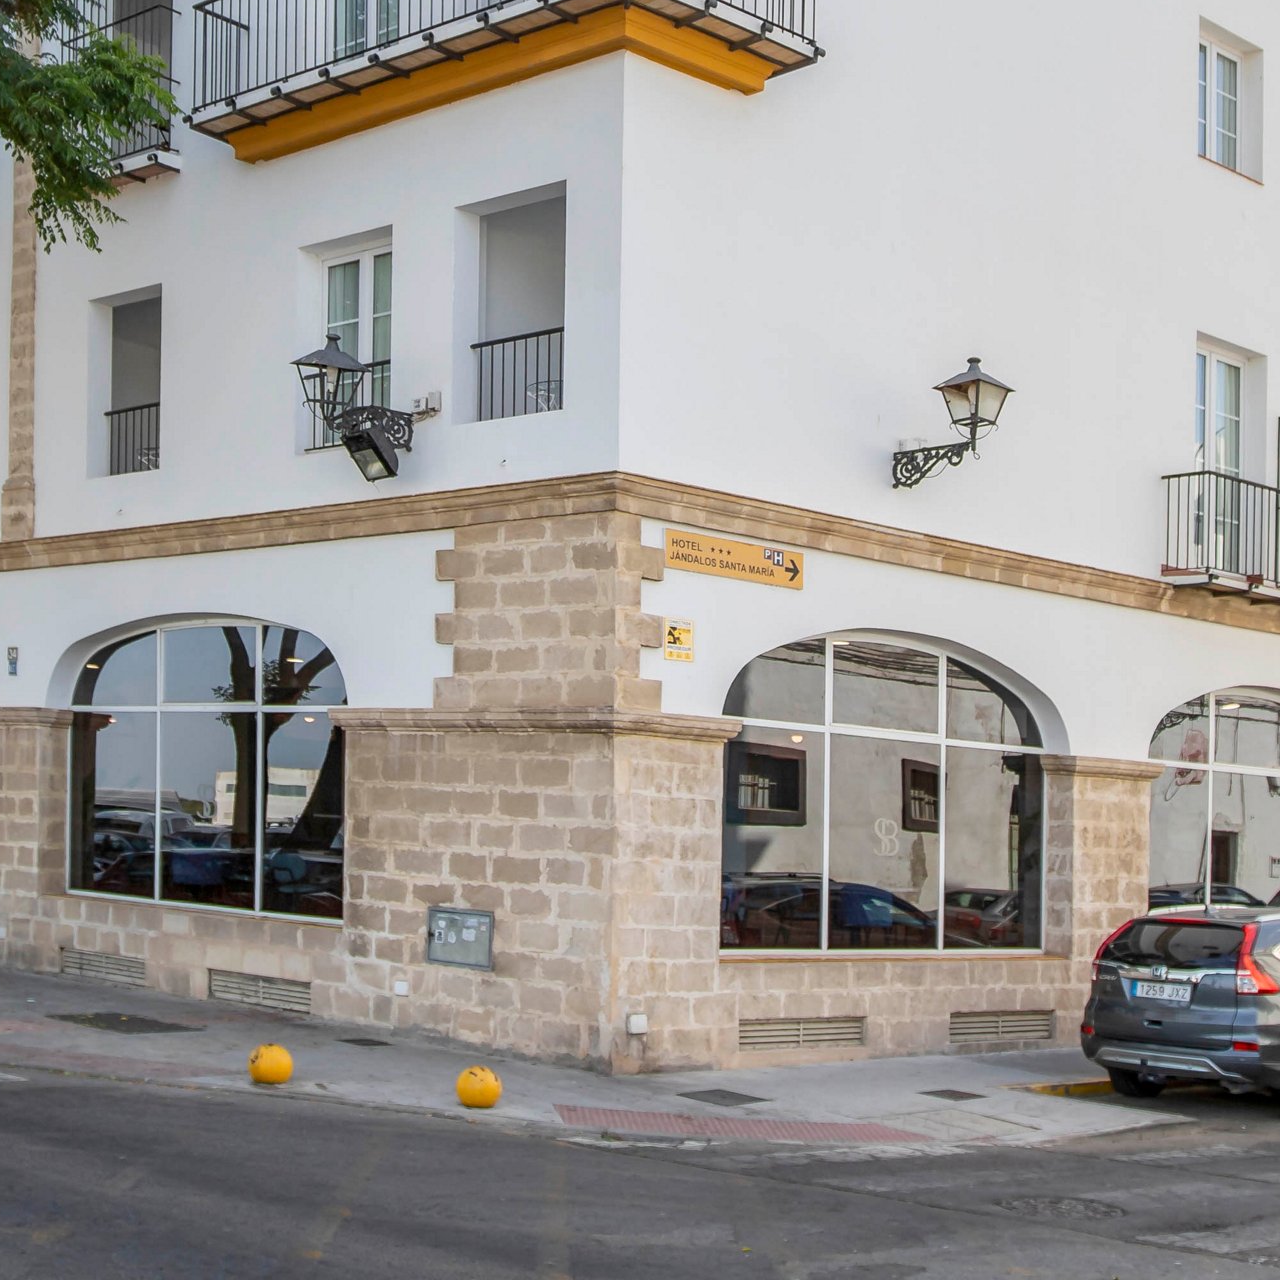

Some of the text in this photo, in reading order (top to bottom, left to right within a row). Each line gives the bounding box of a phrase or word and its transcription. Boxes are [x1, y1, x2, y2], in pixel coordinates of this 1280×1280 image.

[671, 538, 703, 552] HOTEL
[670, 551, 775, 578] JÁNDALOS SANTA MARÍA
[774, 552, 783, 566] H
[1140, 984, 1189, 1000] 1259 JXZ
